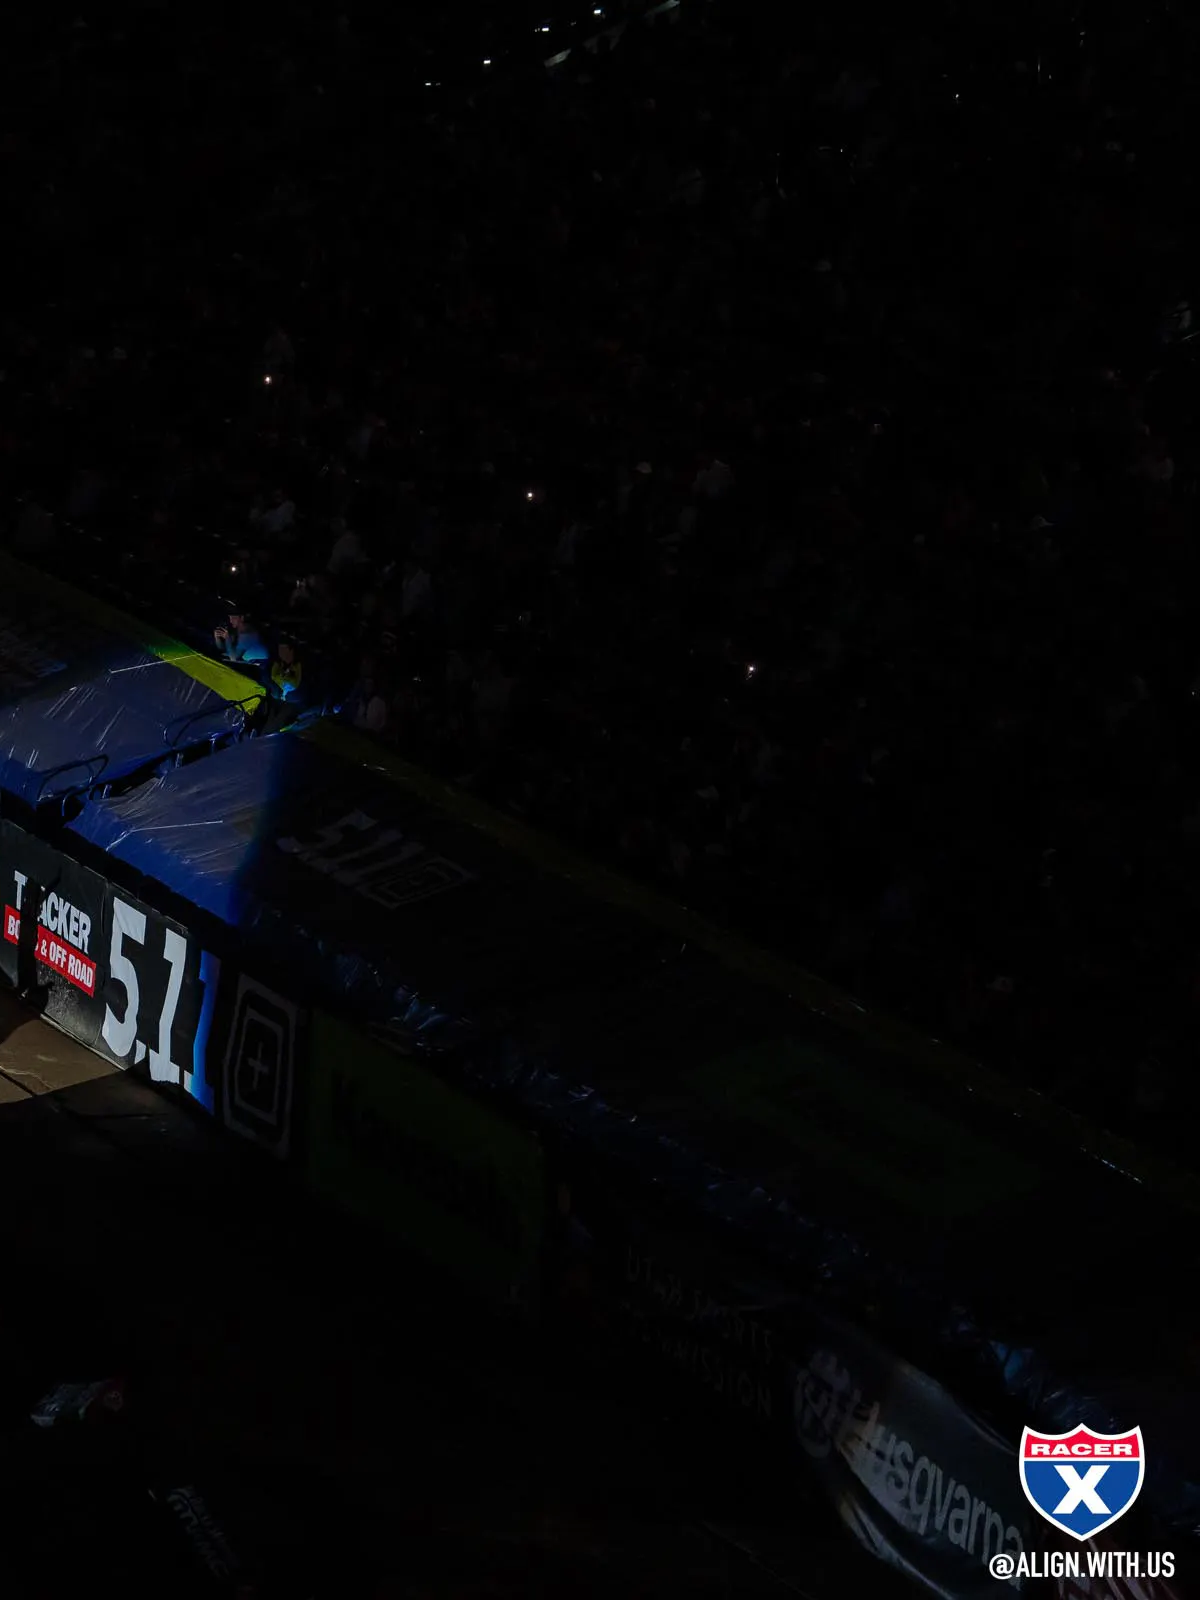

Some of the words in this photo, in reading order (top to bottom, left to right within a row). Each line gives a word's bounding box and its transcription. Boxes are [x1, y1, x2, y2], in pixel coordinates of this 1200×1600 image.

[14, 870, 92, 954] TACKER
[49, 947, 67, 970] OFF
[67, 957, 94, 989] ROAD
